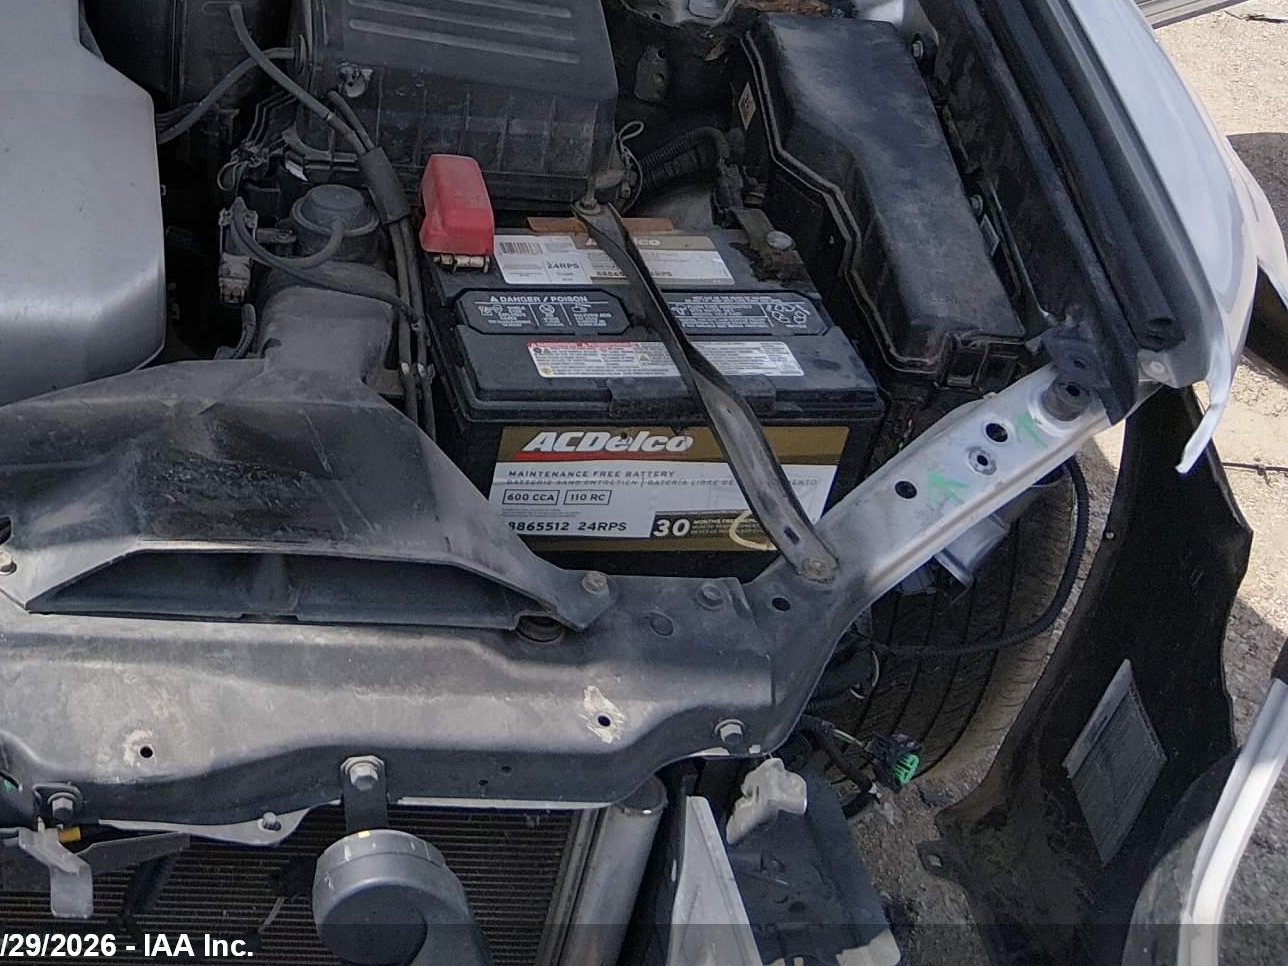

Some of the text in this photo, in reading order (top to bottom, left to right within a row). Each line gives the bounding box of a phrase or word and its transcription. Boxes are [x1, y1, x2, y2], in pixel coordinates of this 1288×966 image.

[522, 431, 694, 452] ACDelco
[508, 470, 676, 478] MAINTENANCE FREE BATTERY
[507, 493, 606, 501] 600 CCA 110 RC
[577, 521, 628, 532] 24RPS
[653, 518, 691, 537] 30
